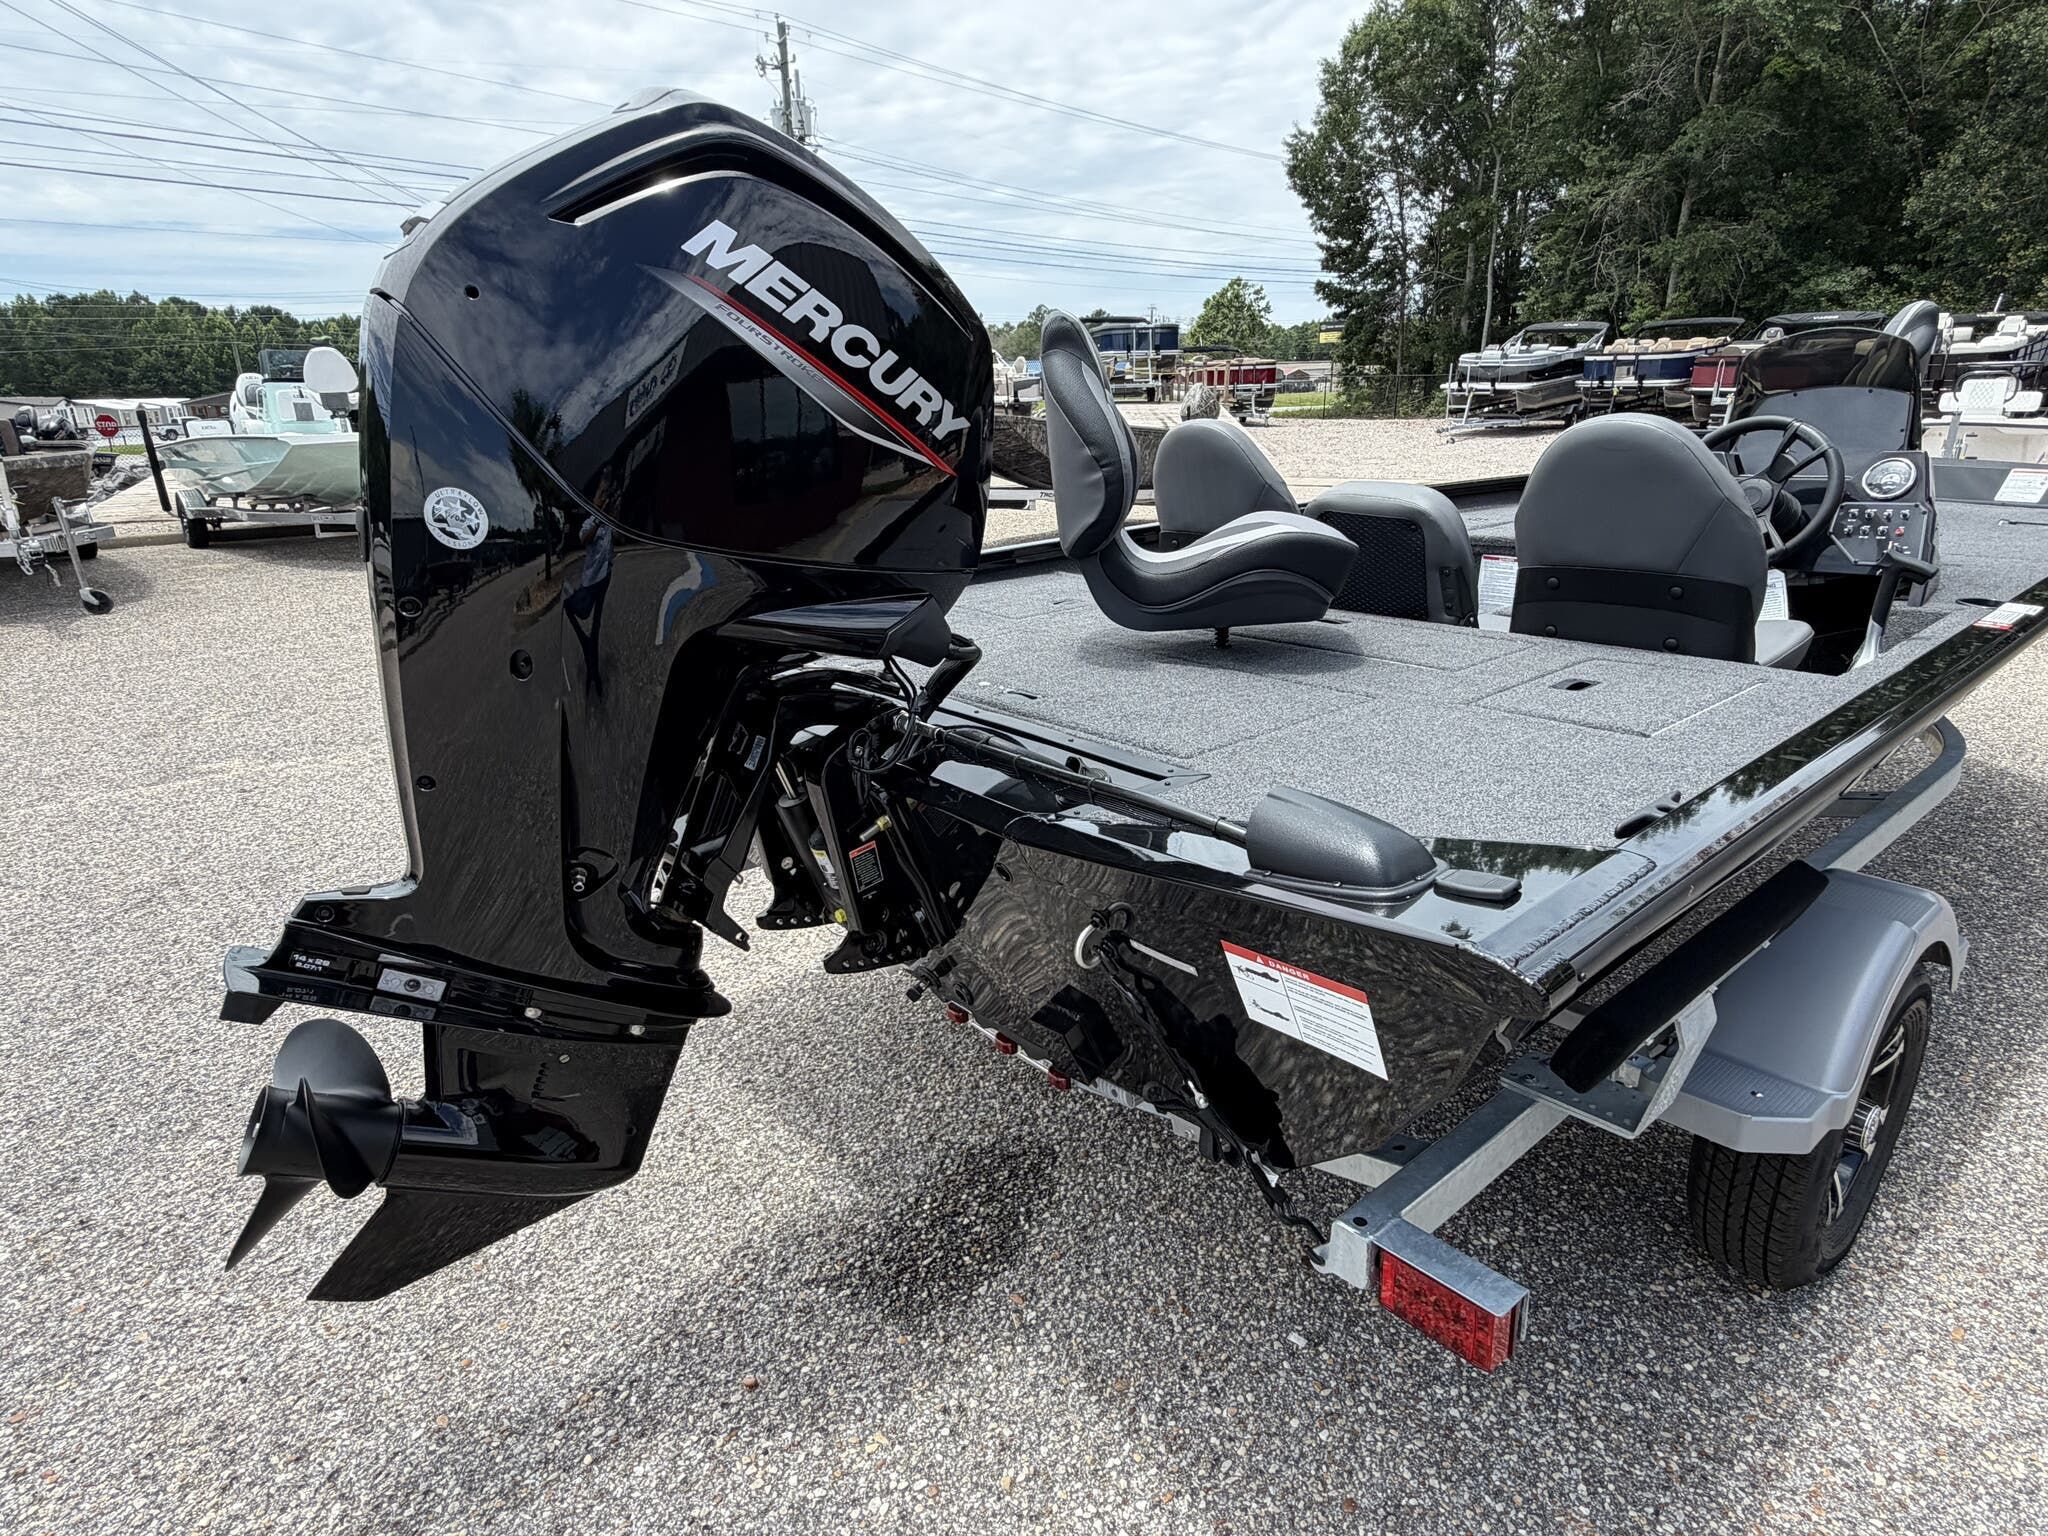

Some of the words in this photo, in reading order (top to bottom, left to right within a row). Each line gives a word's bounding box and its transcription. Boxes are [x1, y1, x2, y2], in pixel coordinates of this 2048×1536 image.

[680, 219, 971, 440] MERCURY
[714, 303, 826, 385] FOURSTROKE
[96, 421, 118, 431] STOP
[435, 489, 462, 498] ULTRA
[468, 497, 484, 515] LOW
[1268, 959, 1310, 981] DANGER
